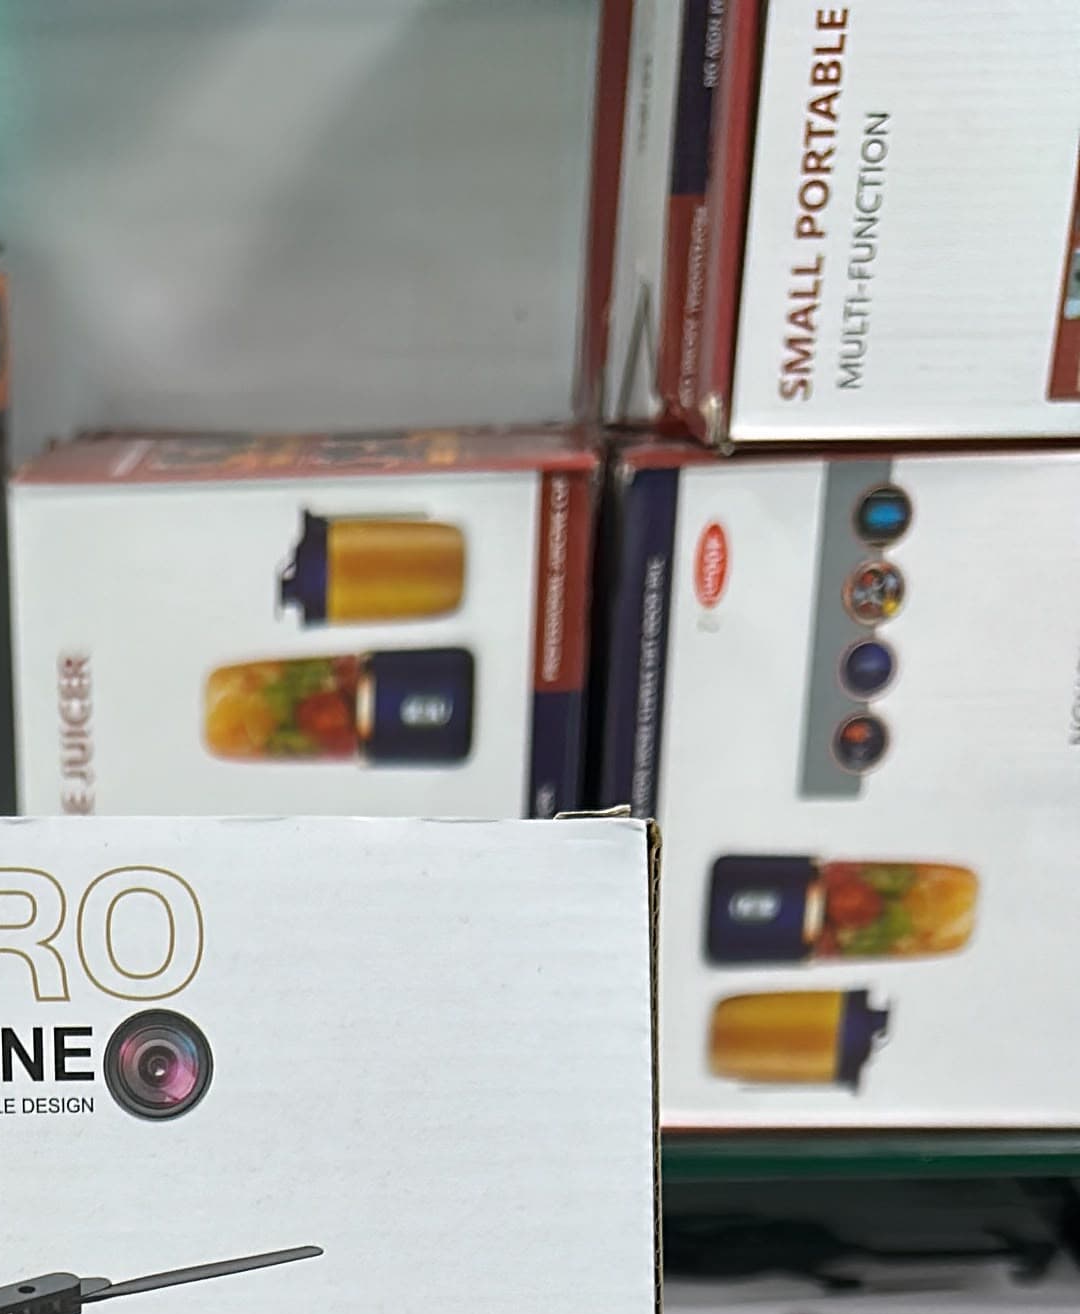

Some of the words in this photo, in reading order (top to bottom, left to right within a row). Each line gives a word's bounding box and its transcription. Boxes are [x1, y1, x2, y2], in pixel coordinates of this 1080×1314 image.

[796, 7, 850, 240] PORTABLE
[837, 111, 891, 390] MULTI-FUNCTION
[779, 257, 825, 401] SMALL
[58, 650, 96, 787] JUICER
[22, 1097, 94, 1114] DESIGN
